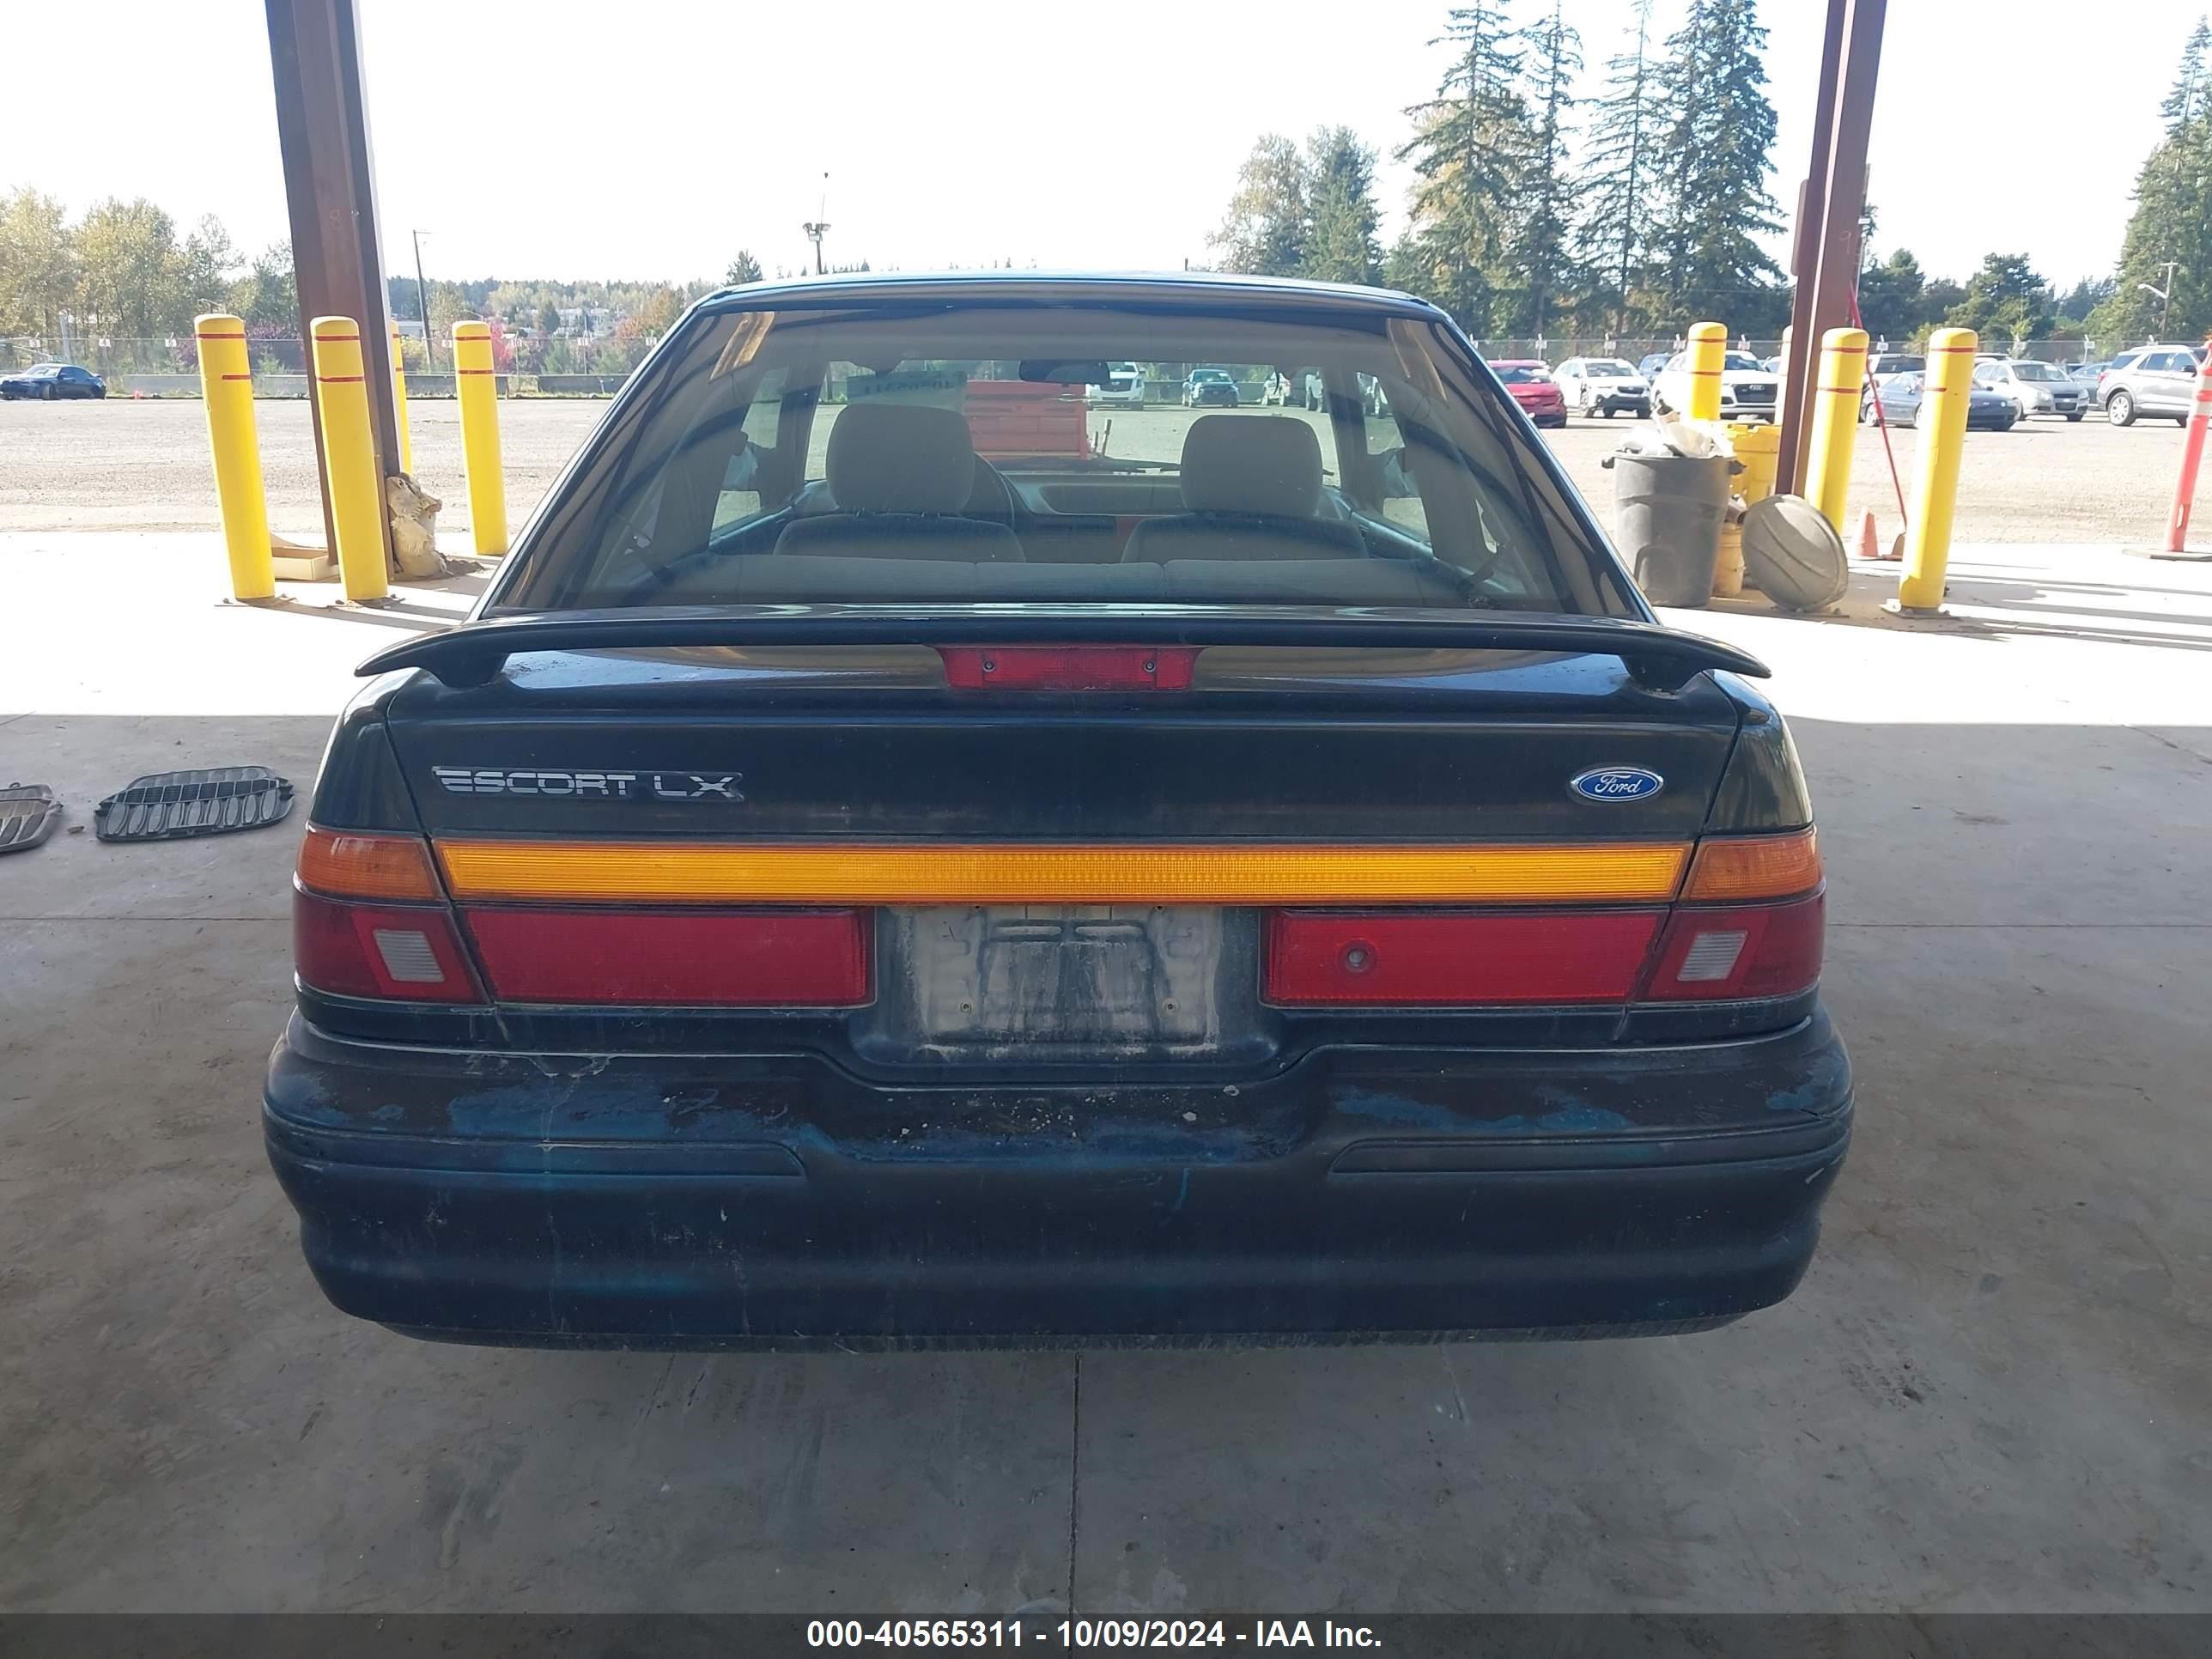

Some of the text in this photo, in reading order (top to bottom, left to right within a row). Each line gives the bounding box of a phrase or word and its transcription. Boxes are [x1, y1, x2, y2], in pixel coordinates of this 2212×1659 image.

[435, 770, 735, 797] ESCORT LX
[1594, 774, 1643, 793] Ford
